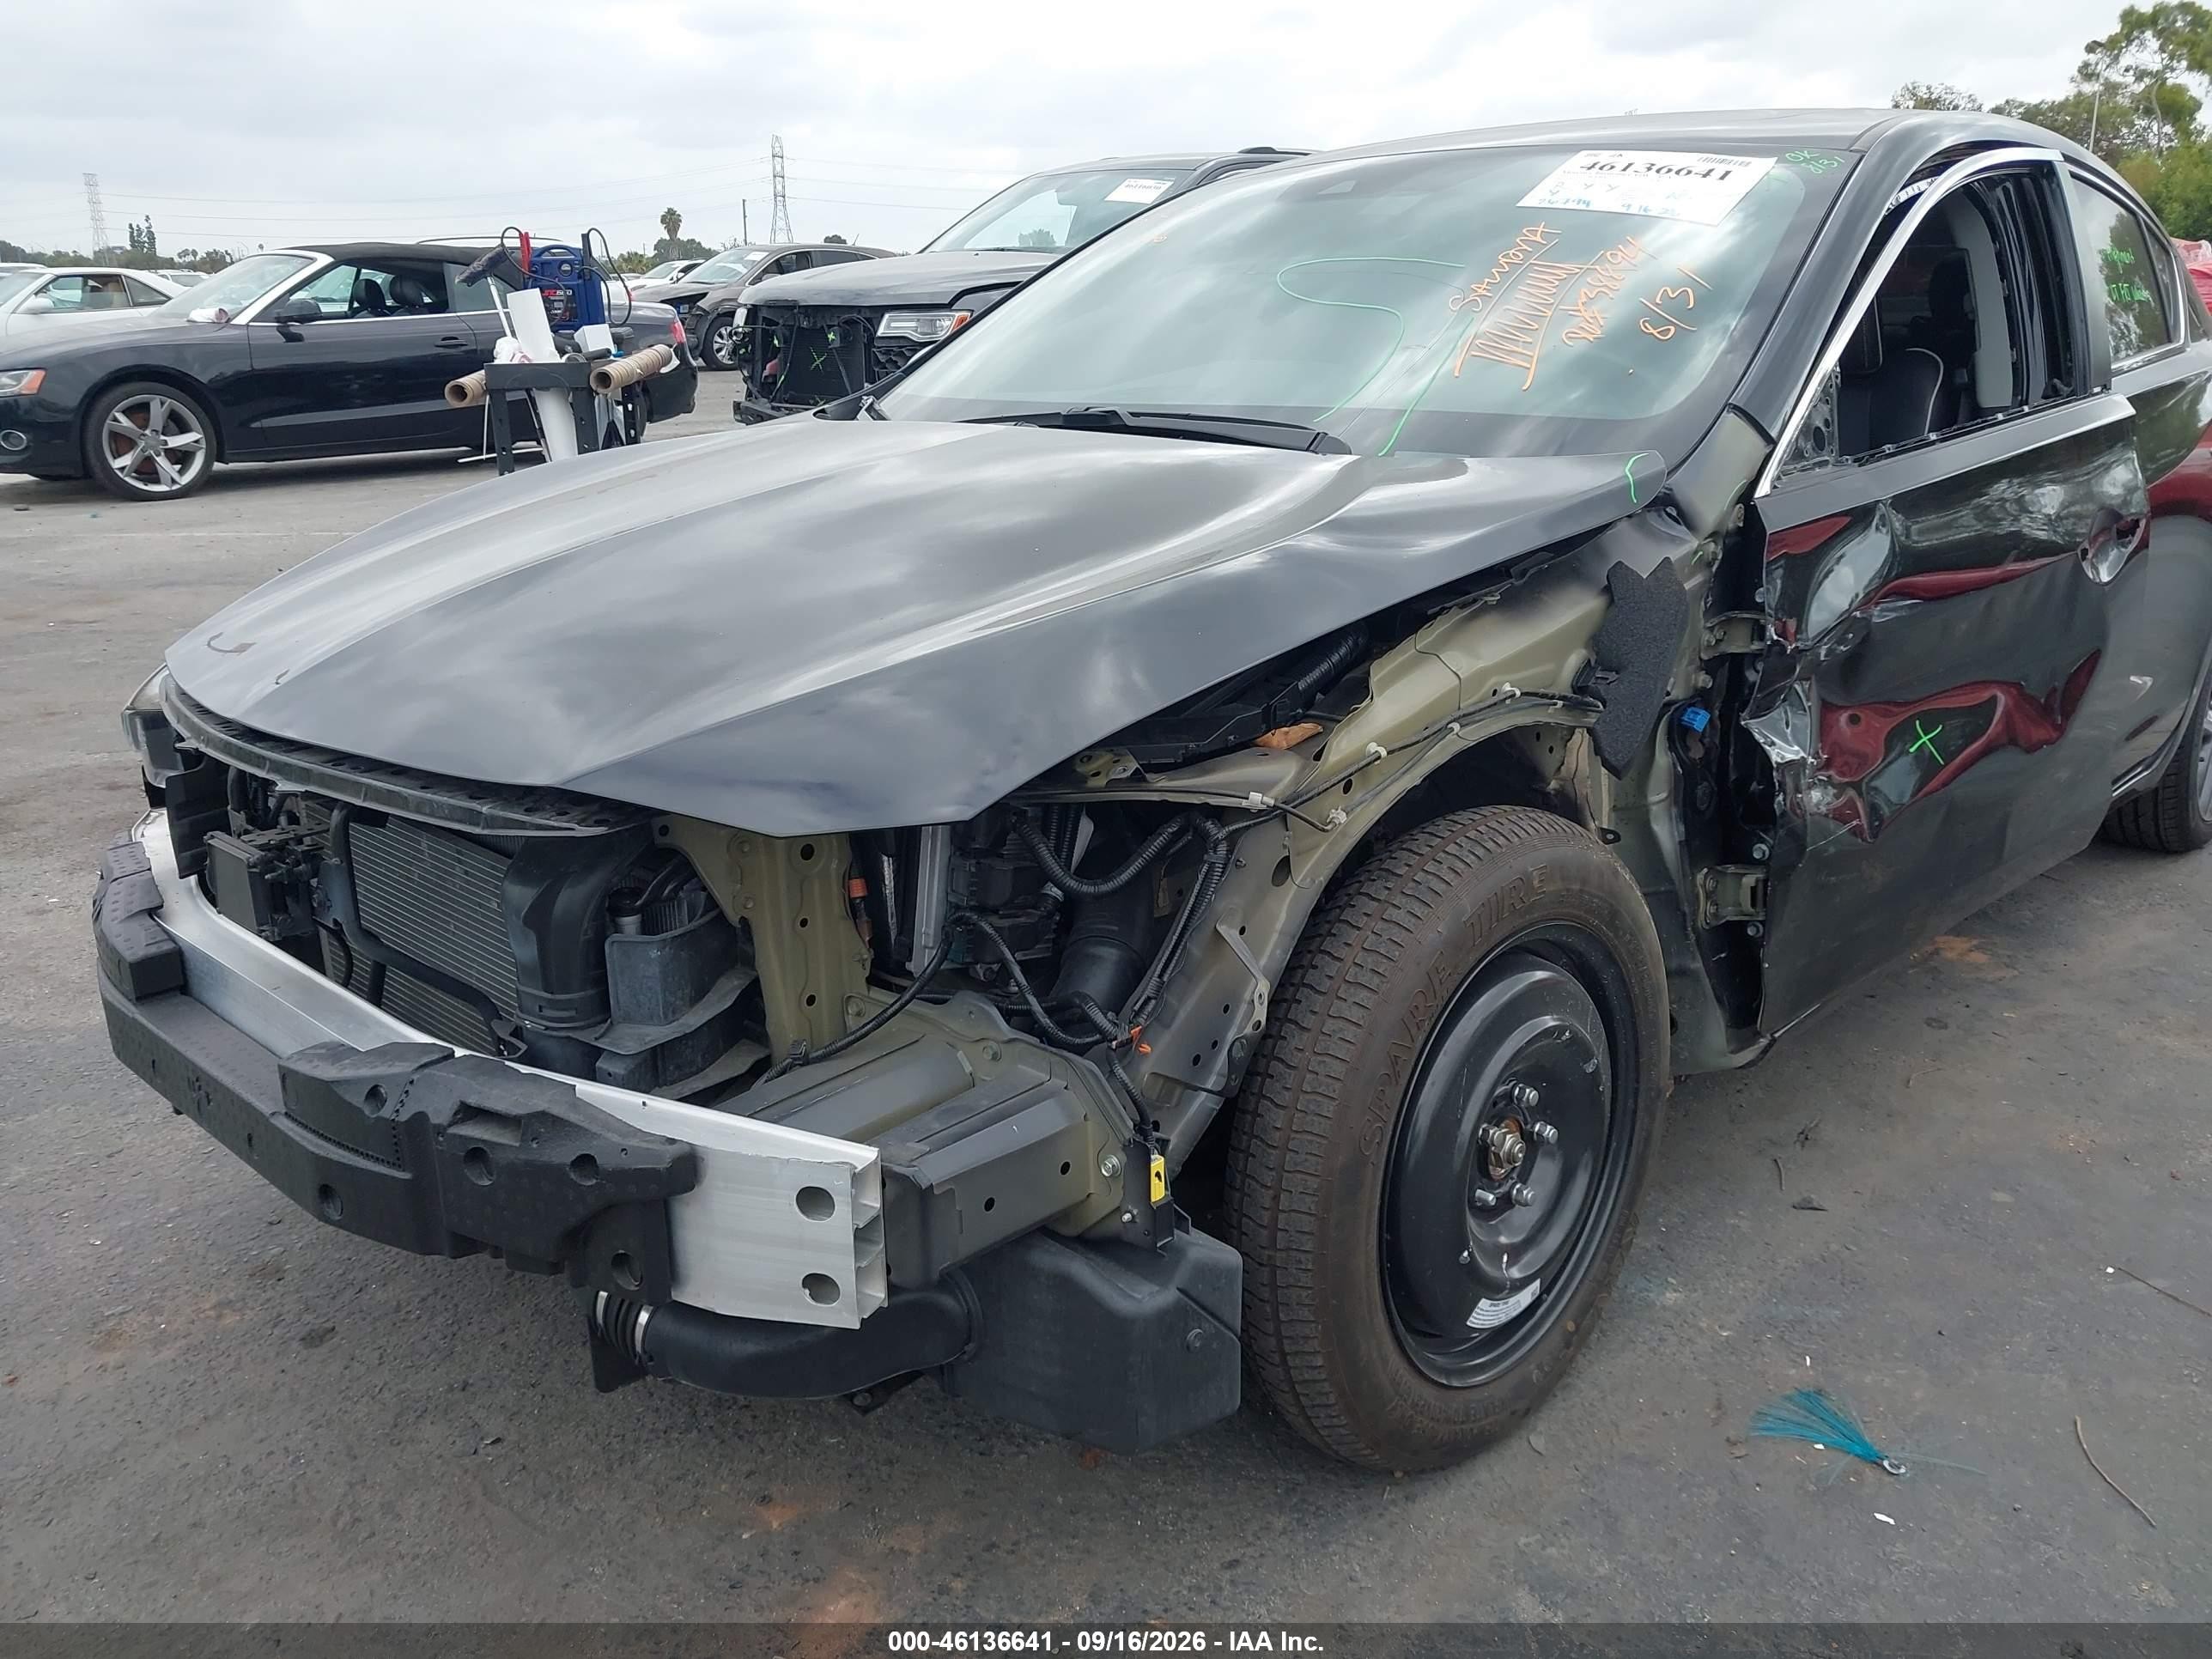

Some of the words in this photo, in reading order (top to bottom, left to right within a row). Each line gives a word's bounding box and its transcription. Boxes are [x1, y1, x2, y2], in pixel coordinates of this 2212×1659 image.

[1579, 161, 1733, 181] 46136641
[1359, 950, 1458, 1158] SPARE
[1462, 864, 1548, 946] TIRE
